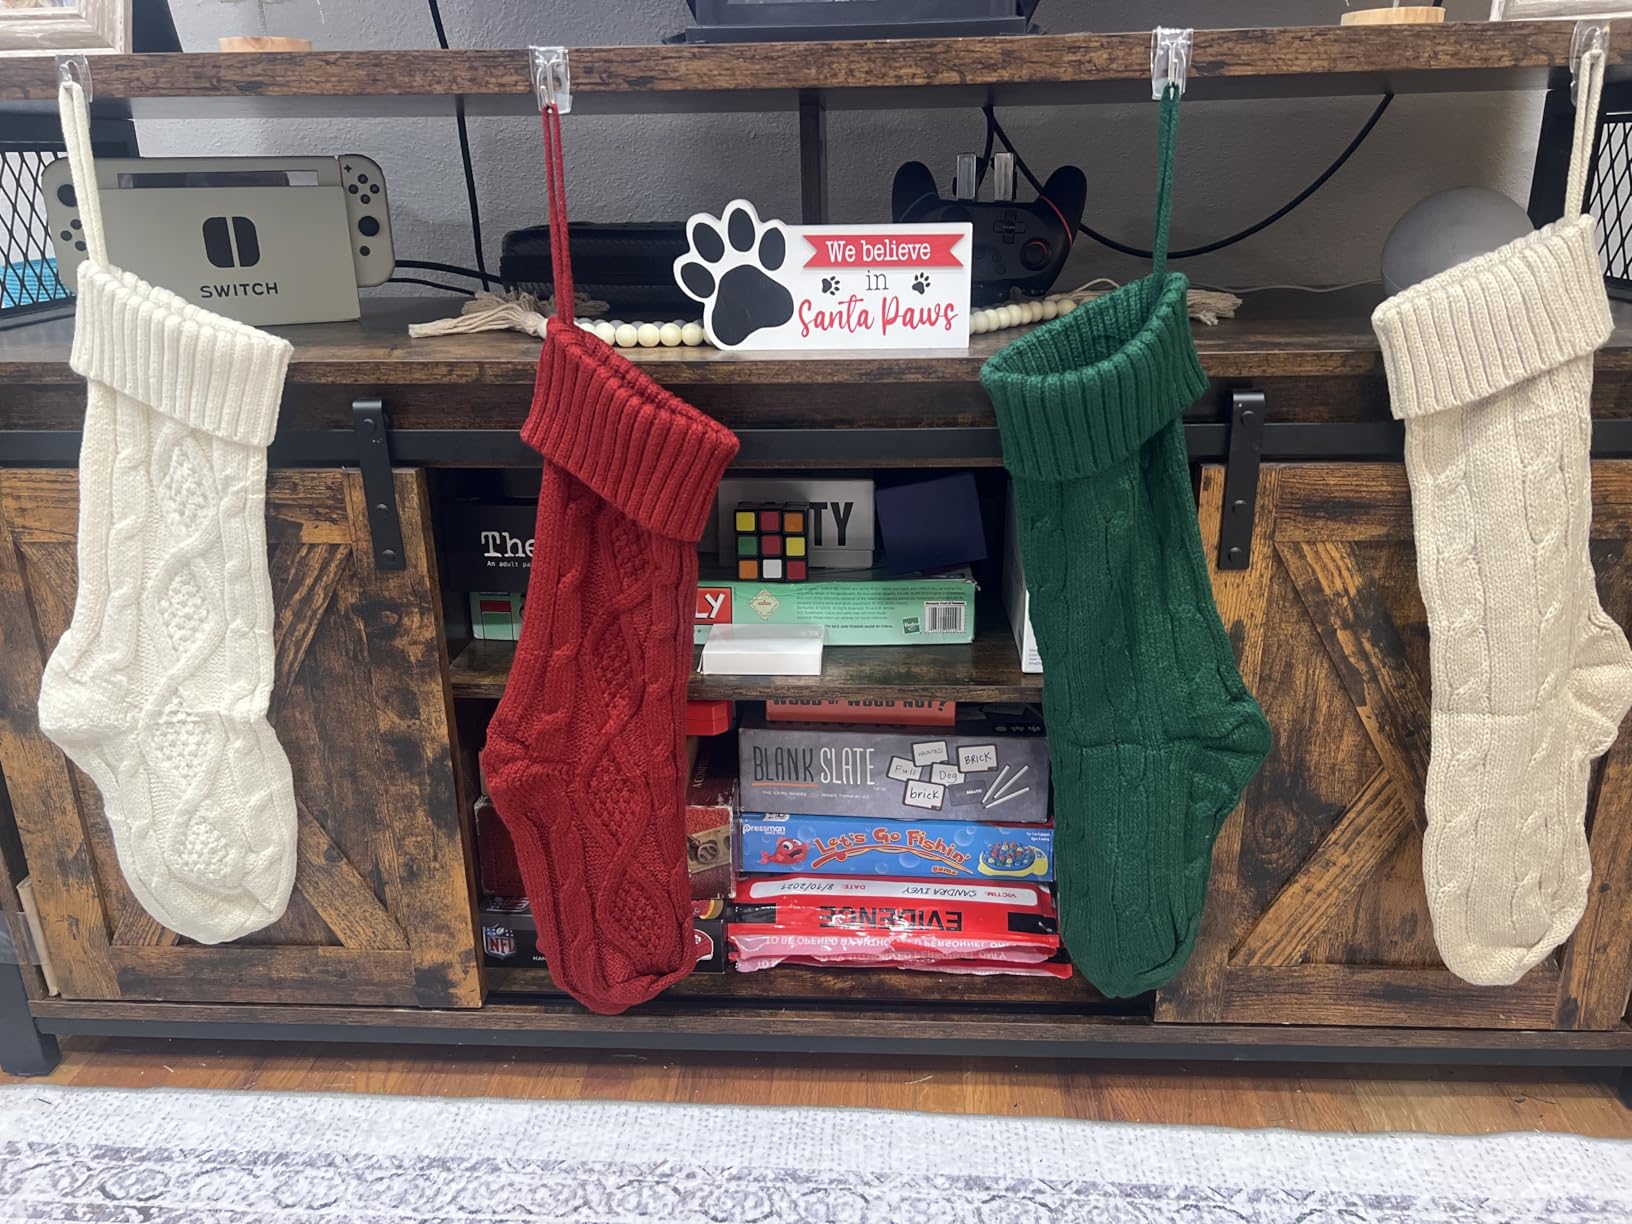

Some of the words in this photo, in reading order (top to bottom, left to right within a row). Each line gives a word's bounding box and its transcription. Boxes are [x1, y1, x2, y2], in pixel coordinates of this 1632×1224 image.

[825, 240, 856, 263] We
[860, 239, 931, 262] believe
[865, 269, 889, 291] in
[200, 282, 279, 299] SWITCH
[798, 294, 875, 338] Santa
[881, 296, 959, 336] Paws
[808, 502, 854, 546] TY
[481, 531, 536, 558] The
[753, 746, 814, 782] BLANK
[820, 747, 875, 785] SLATE
[964, 752, 992, 765] BRICK
[895, 764, 916, 776] Full
[939, 770, 958, 784] Dog
[909, 786, 939, 800] brick
[742, 823, 786, 835] pressman
[813, 831, 867, 855] Let's
[871, 826, 901, 844] Go
[905, 828, 972, 864] Fishin'
[931, 865, 959, 876] game
[902, 886, 931, 894] IVEY
[933, 886, 977, 897] SANDRA
[818, 905, 962, 932] EVIDENCE
